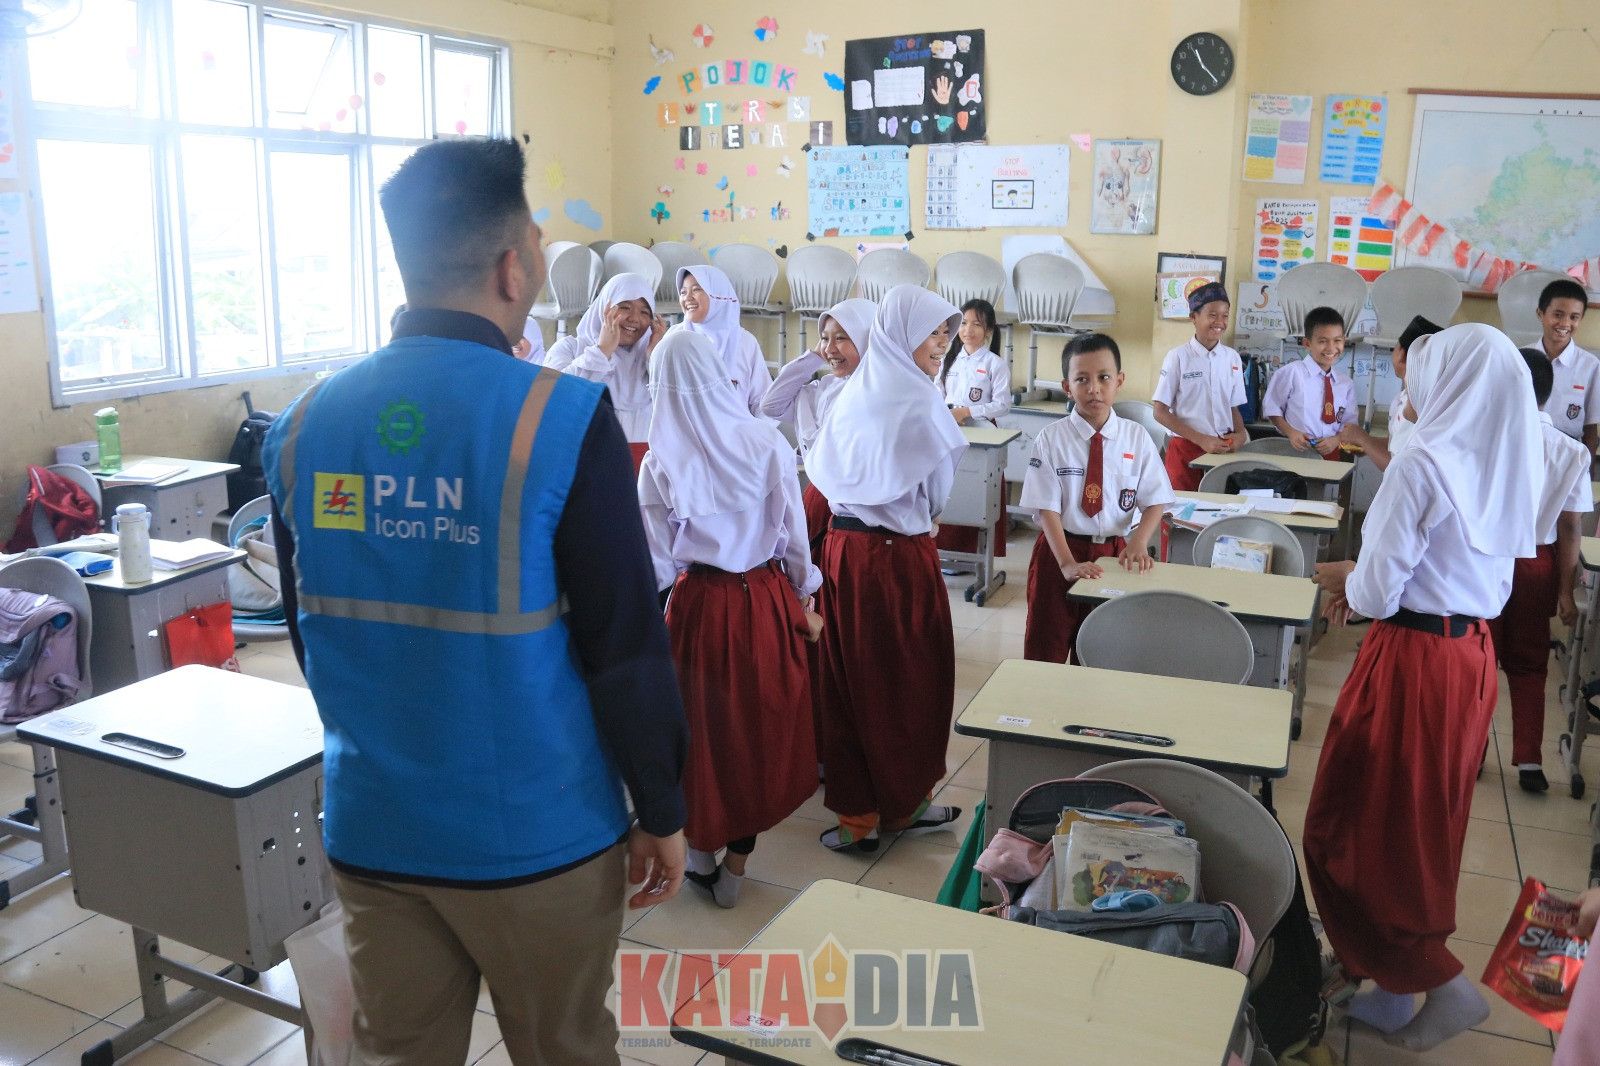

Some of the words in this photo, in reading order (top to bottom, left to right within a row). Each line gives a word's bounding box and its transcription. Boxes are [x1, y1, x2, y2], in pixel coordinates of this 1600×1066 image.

[1197, 37, 1205, 45] 12
[1219, 46, 1225, 54] 2
[1179, 51, 1187, 60] 10
[682, 61, 795, 93] POJOK
[373, 474, 463, 510] PLN
[375, 513, 426, 539] Icon
[434, 516, 480, 545] Plus
